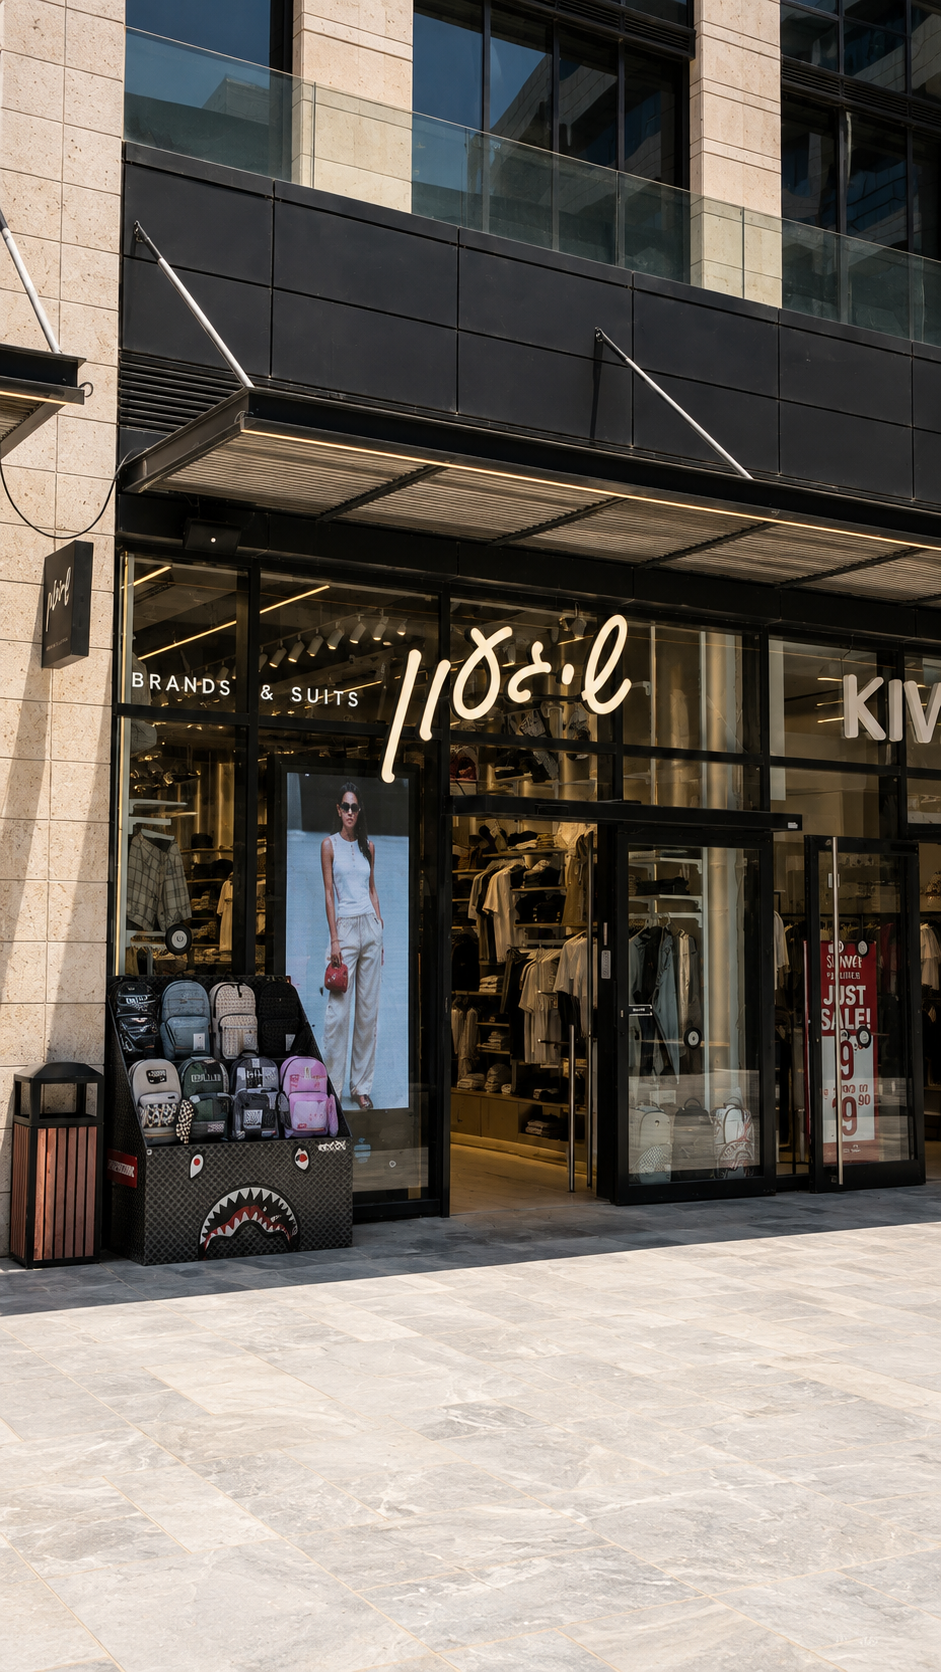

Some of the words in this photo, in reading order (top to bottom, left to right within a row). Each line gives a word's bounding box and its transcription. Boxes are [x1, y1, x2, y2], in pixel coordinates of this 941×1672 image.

[132, 671, 231, 696] BRANDS
[260, 685, 274, 701] &
[291, 686, 359, 707] SUITS
[843, 674, 941, 743] KIV
[823, 985, 866, 1006] JUST
[821, 1008, 871, 1030] SALE!
